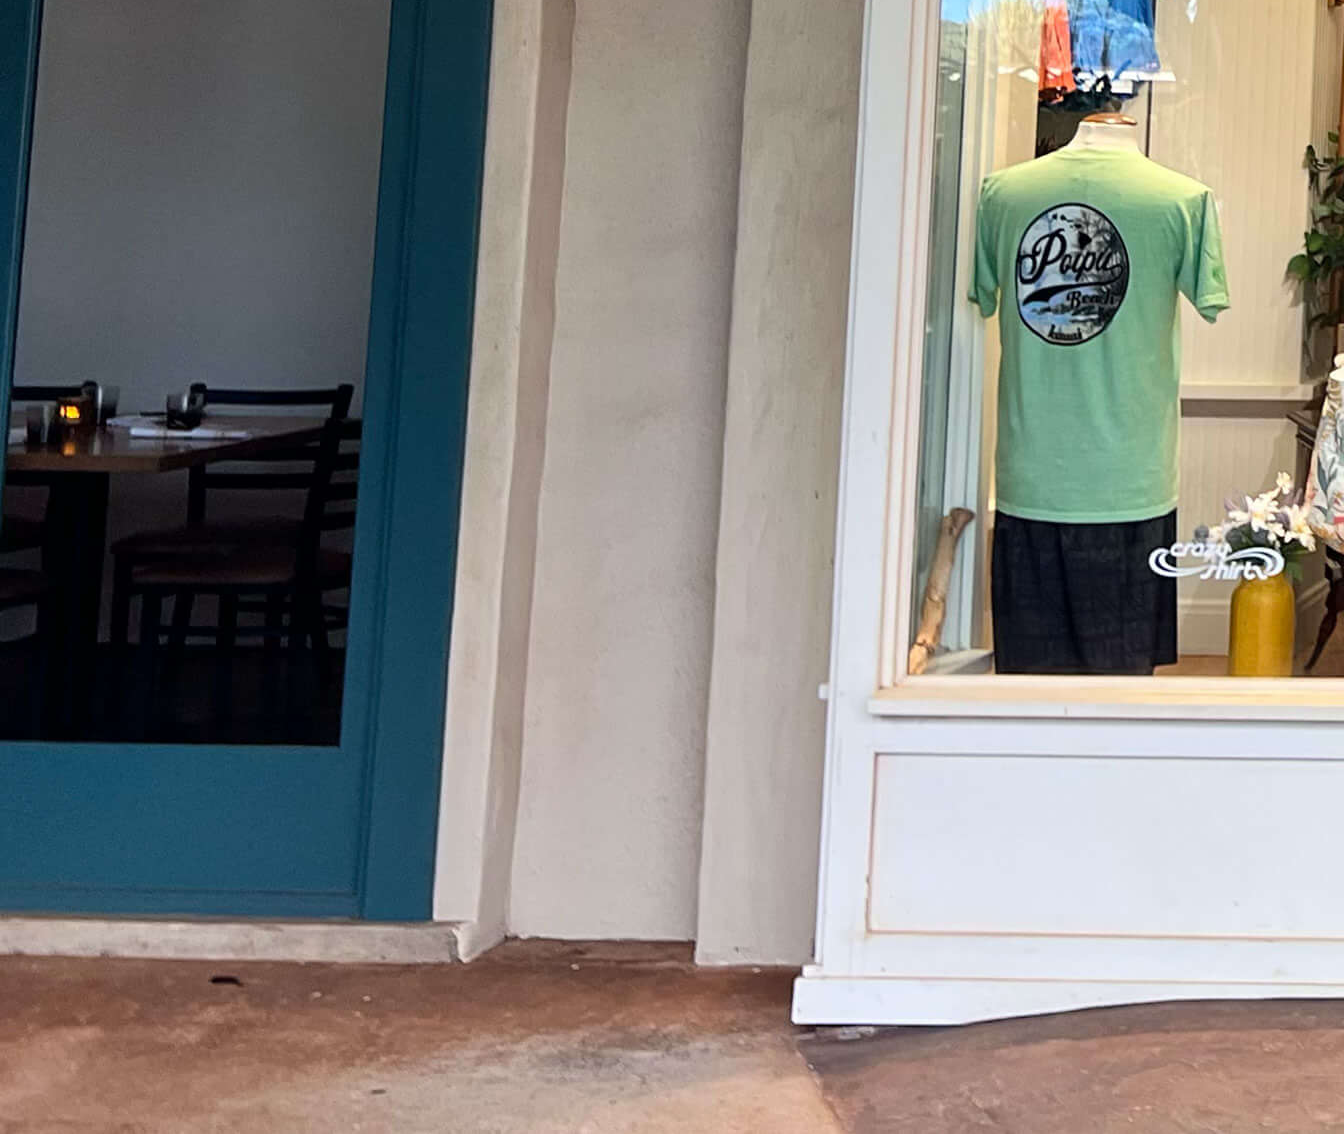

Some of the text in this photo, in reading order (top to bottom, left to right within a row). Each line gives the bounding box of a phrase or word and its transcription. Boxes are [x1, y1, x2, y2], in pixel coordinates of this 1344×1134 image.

[1020, 228, 1122, 284] Poipu
[1066, 289, 1115, 309] Beach
[1170, 542, 1232, 563] crazy
[1200, 560, 1268, 581] shirts
